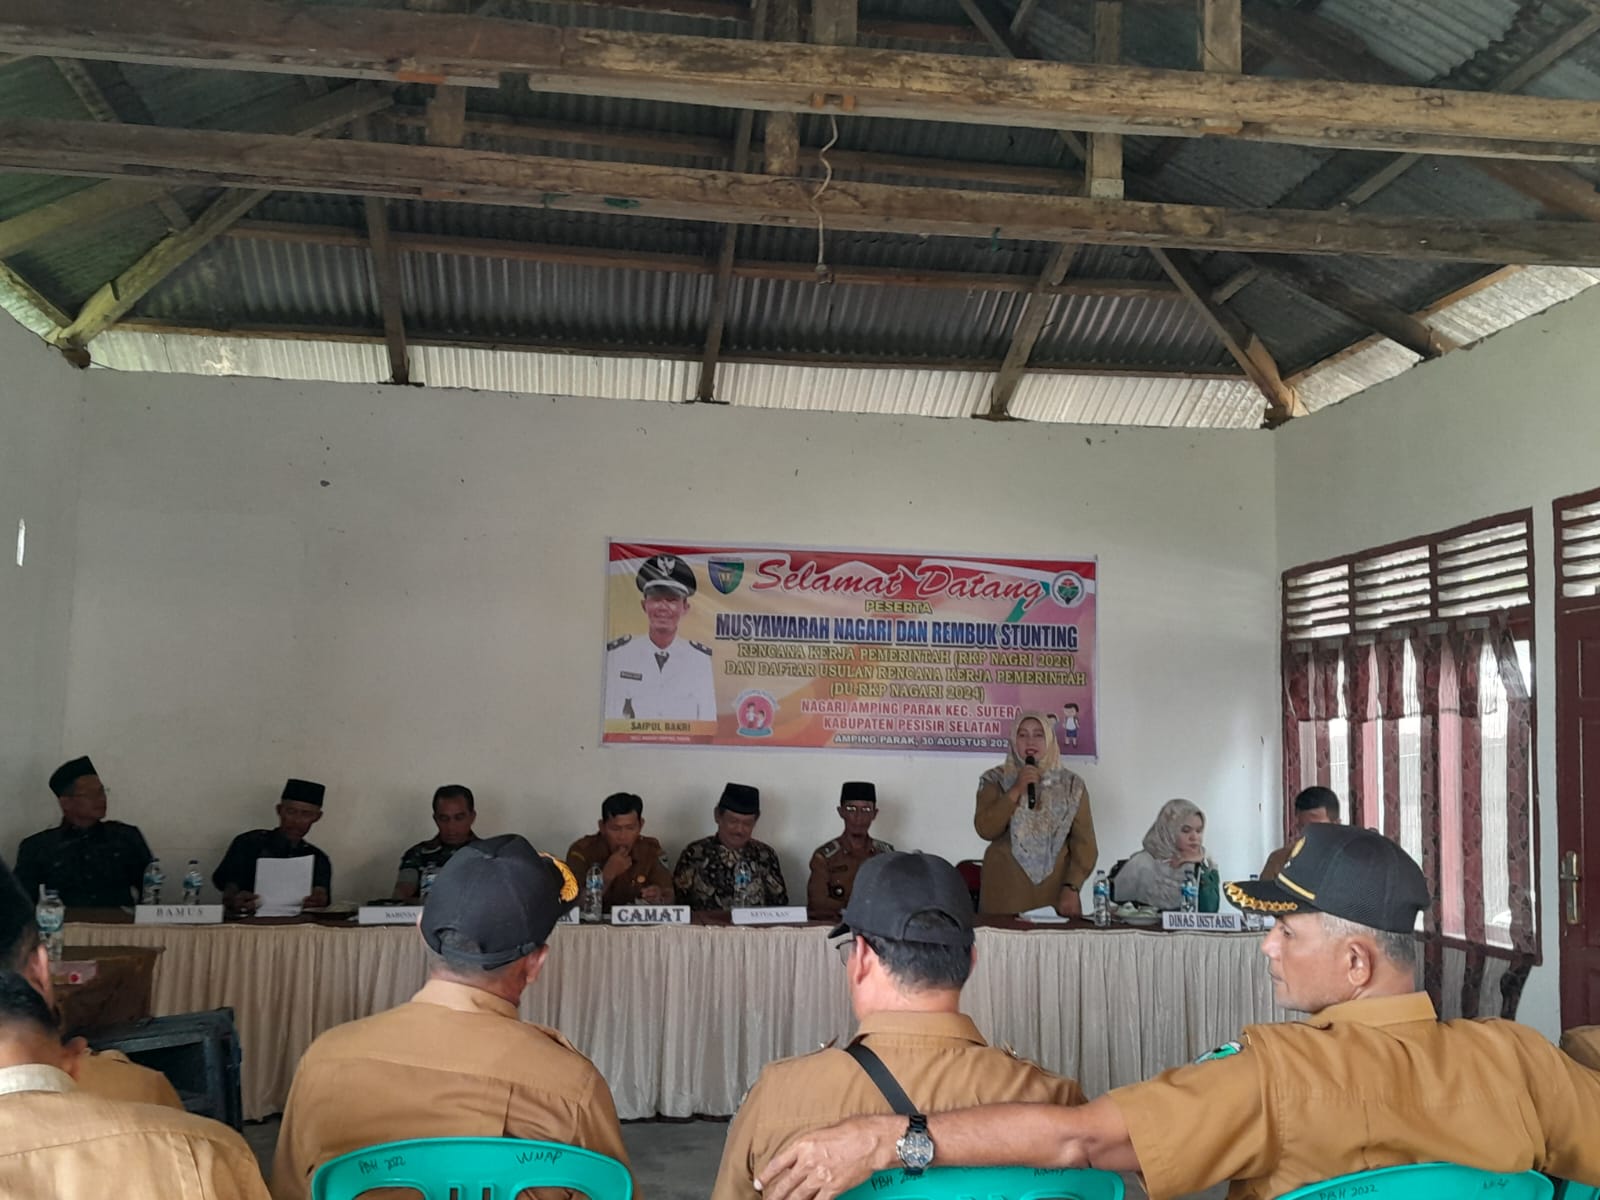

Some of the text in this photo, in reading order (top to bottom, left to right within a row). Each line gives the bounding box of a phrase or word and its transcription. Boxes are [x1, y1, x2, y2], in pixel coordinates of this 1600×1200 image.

[752, 559, 1046, 609] Selamat Datang
[865, 600, 933, 614] PESERTA
[716, 613, 1078, 648] MUSYAWARAH NAGARI DAN REMBUK STUNTING
[738, 644, 1076, 671] RENCANA KERJA PEMERINTAH (RKP NAGRI 2023)
[726, 661, 1087, 686] DAN DAFTAR USULAN RENCANA KERJA PEMERINTAH
[891, 685, 943, 699] NAGARI
[948, 687, 985, 703] 2024)
[801, 700, 847, 713] NAGARI
[851, 702, 899, 715] AMPING
[903, 704, 942, 716] PARAK
[946, 706, 974, 717] KEC.
[824, 717, 1000, 733] KABUPATEN PESISIR SELATAN
[834, 735, 876, 744] AMPING
[879, 736, 919, 747] PARAK,
[922, 737, 935, 746] 30
[938, 738, 986, 748] AGUSTUS
[155, 906, 204, 918] BAMUS
[616, 908, 685, 922] CAMAT
[1168, 914, 1235, 928] DINAS INSTANSI
